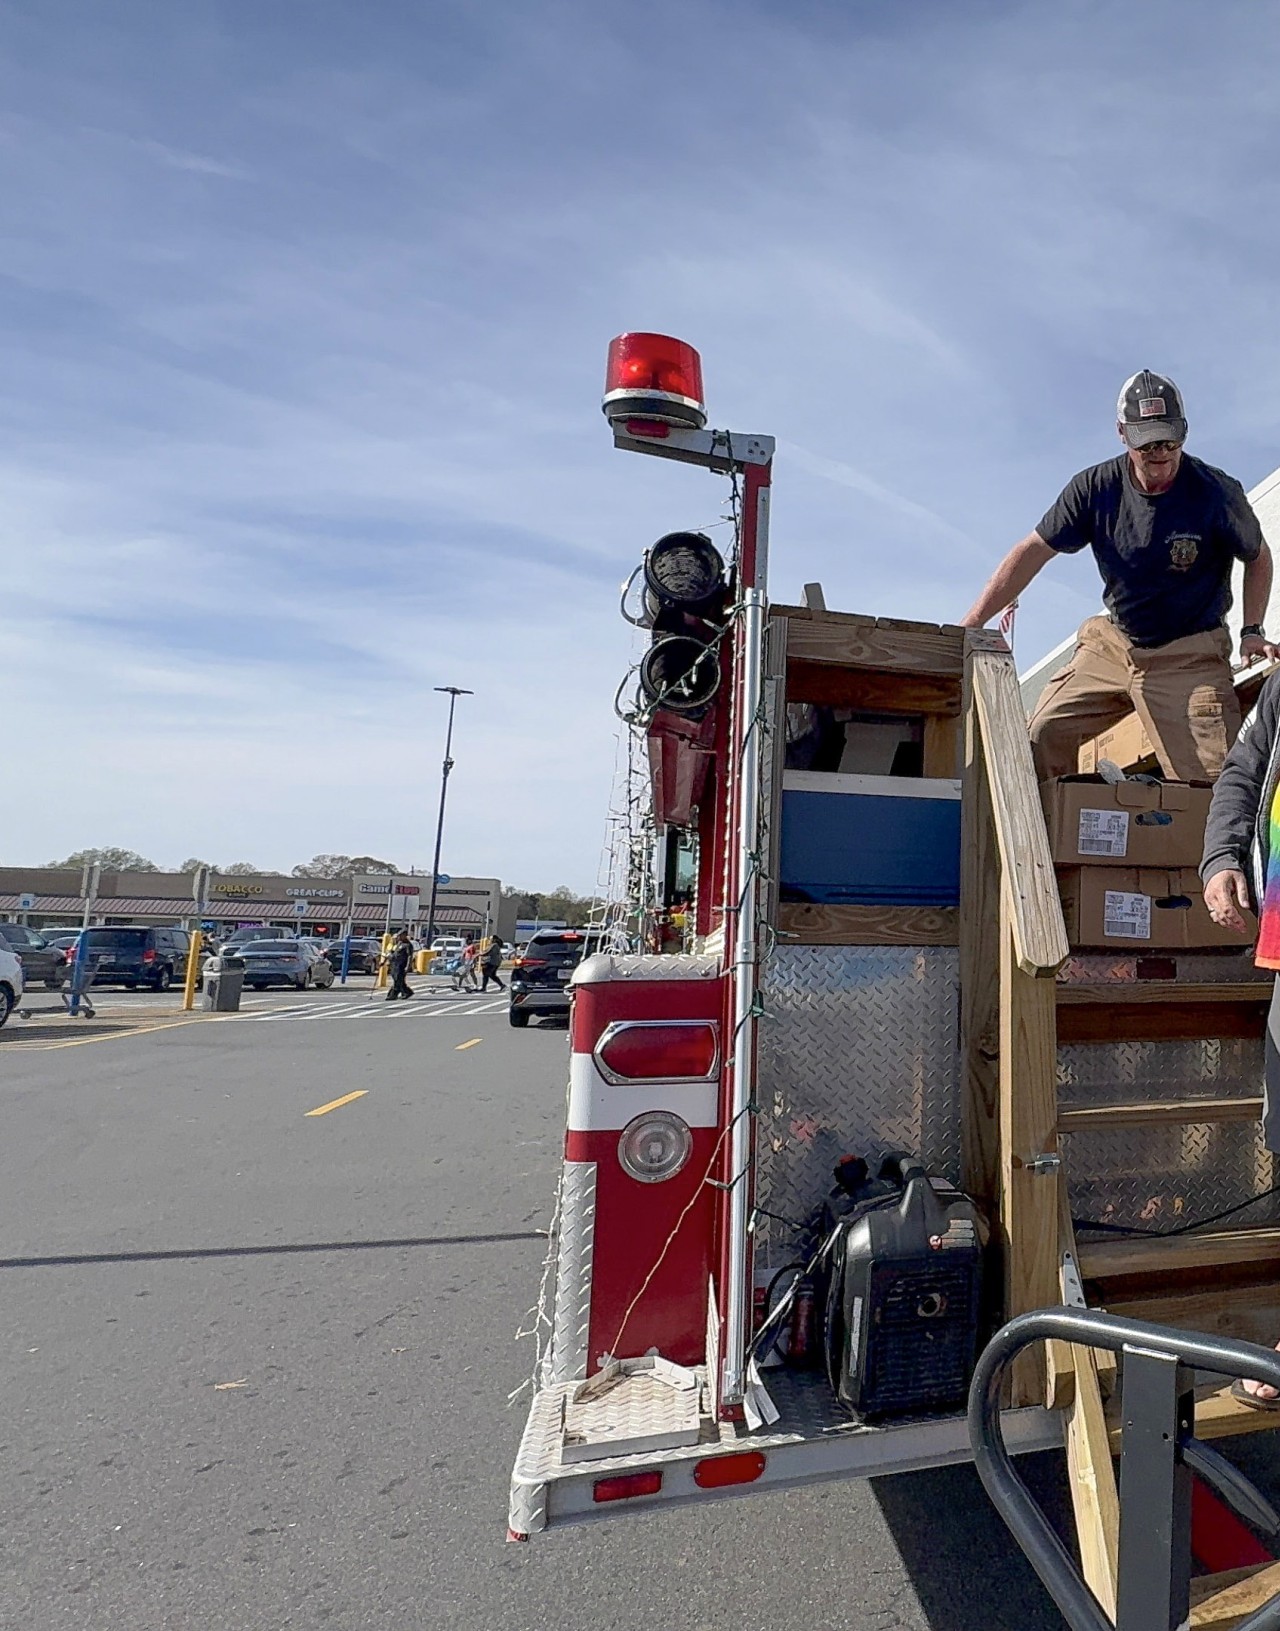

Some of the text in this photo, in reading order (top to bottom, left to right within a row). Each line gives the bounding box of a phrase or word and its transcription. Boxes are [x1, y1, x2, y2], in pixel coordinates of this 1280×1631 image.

[210, 884, 263, 894] TOBACCO
[286, 888, 345, 898] GREAT CLIPS
